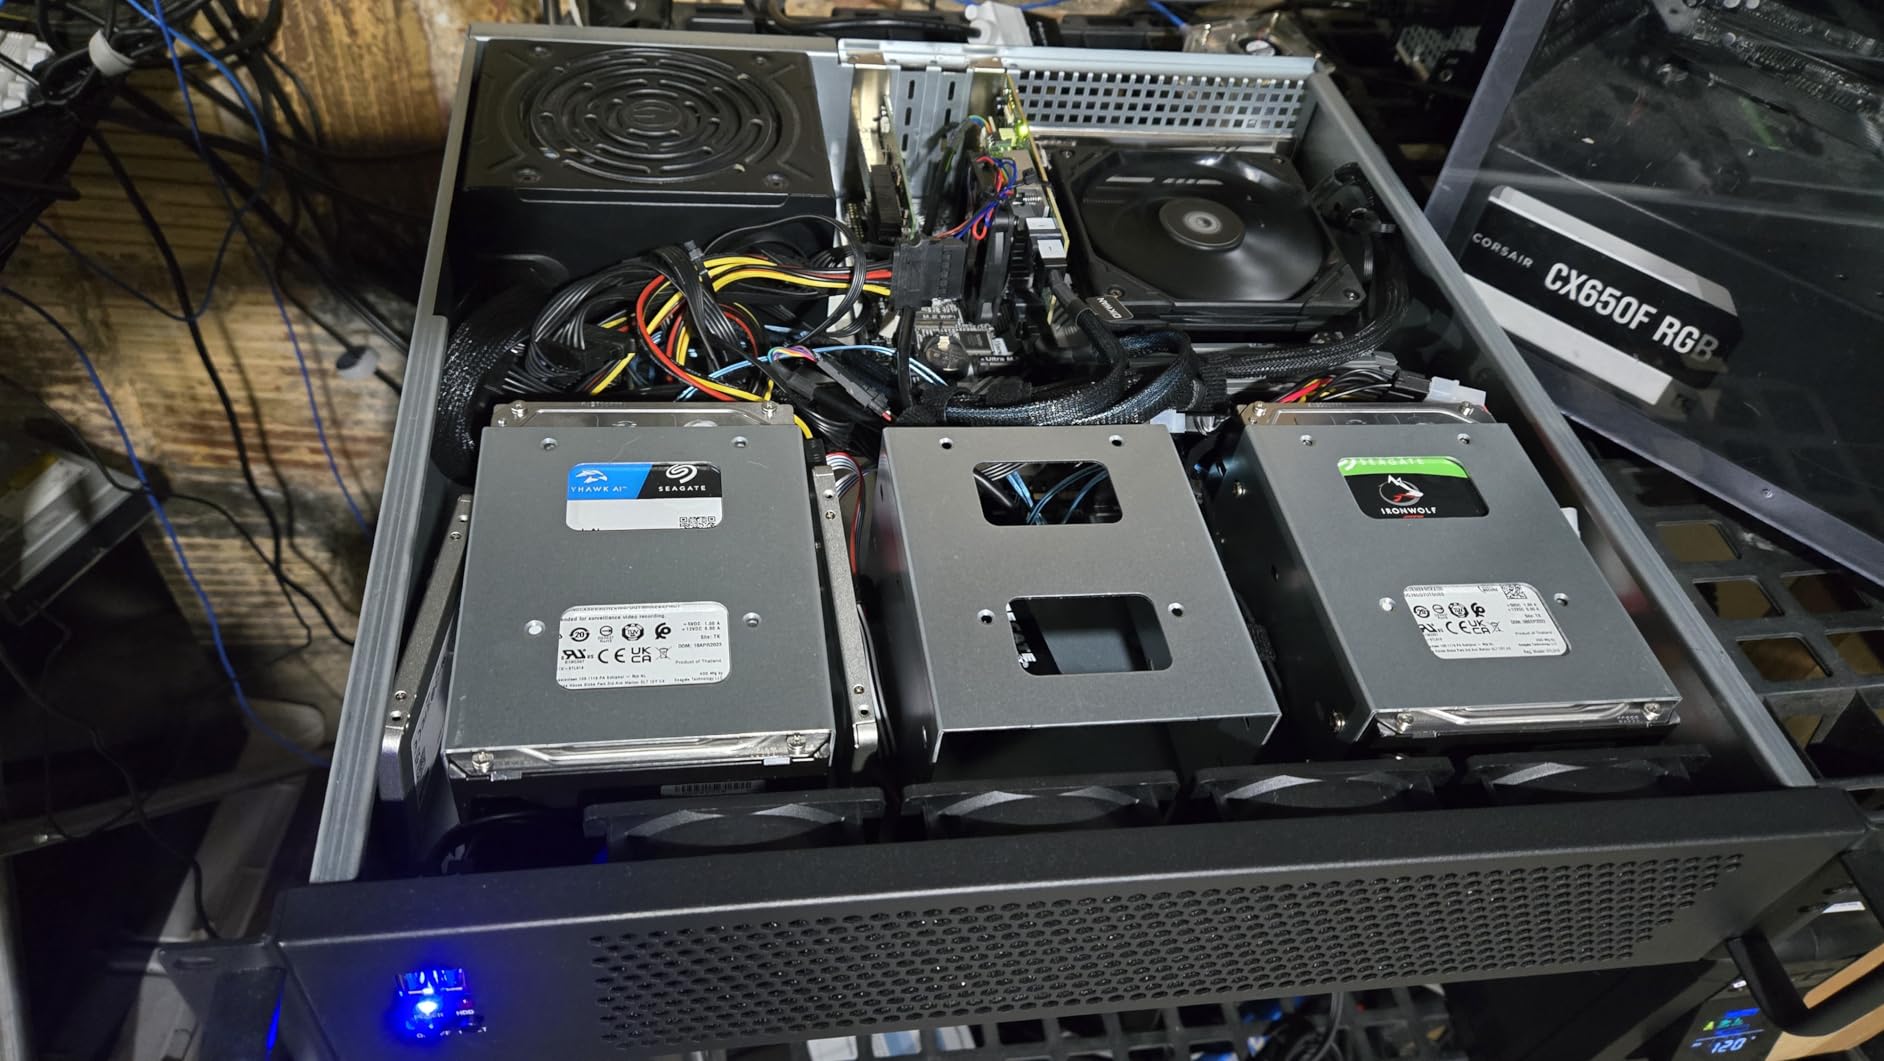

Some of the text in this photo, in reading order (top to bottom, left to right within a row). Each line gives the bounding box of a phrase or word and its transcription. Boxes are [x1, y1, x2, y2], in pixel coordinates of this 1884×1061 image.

[1472, 232, 1534, 268] CORSAIR
[1544, 262, 1720, 362] CX650F RGB
[658, 484, 706, 492] SEAGATE
[1380, 507, 1437, 515] IRONWOLF
[631, 647, 652, 655] UK
[631, 655, 652, 663] CA
[1711, 1037, 1747, 1054] 120
